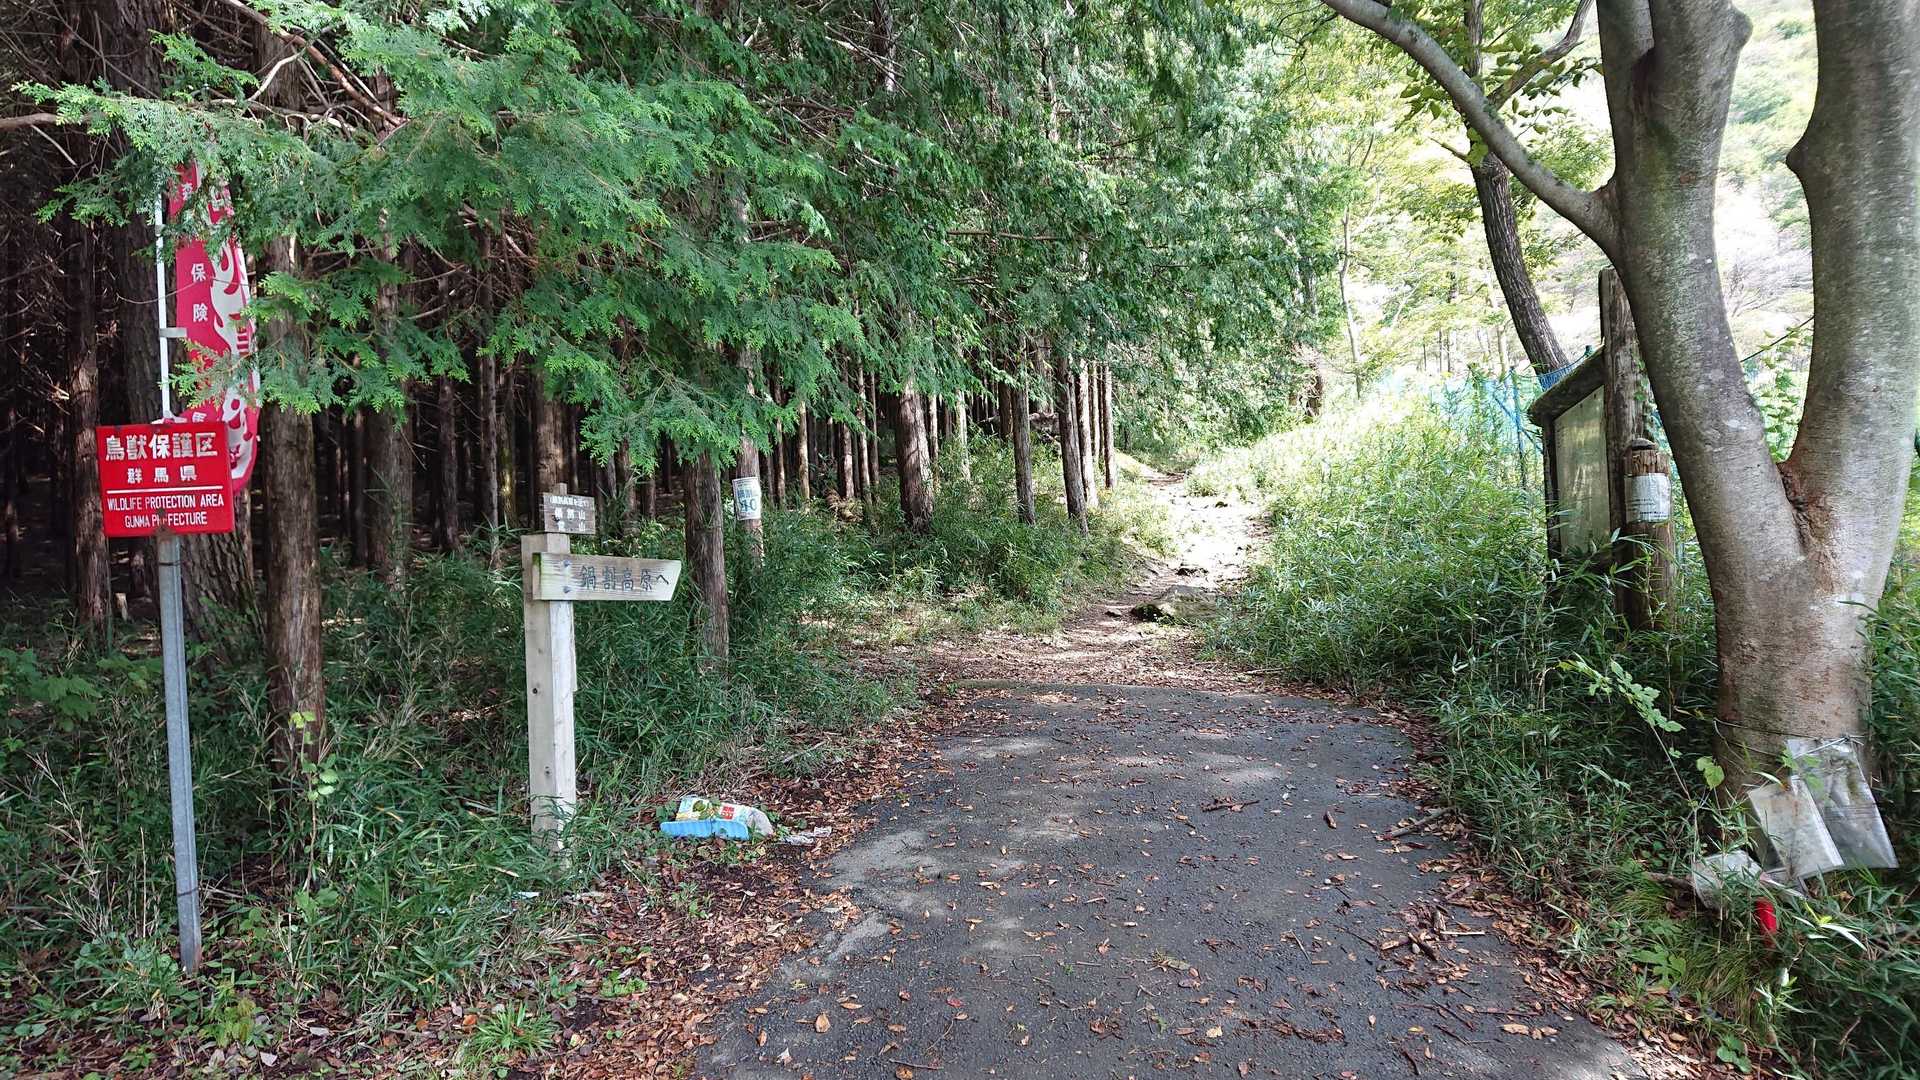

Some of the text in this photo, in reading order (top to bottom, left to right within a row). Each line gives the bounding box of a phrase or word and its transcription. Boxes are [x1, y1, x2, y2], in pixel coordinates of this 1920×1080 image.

[105, 432, 217, 461] 鳥獣保護区
[127, 465, 197, 484] 群馬県
[107, 493, 224, 511] WILDLIFE PROTECTION AREA
[125, 515, 150, 528] GUNMA
[580, 565, 669, 592] 鍋割高原へ
